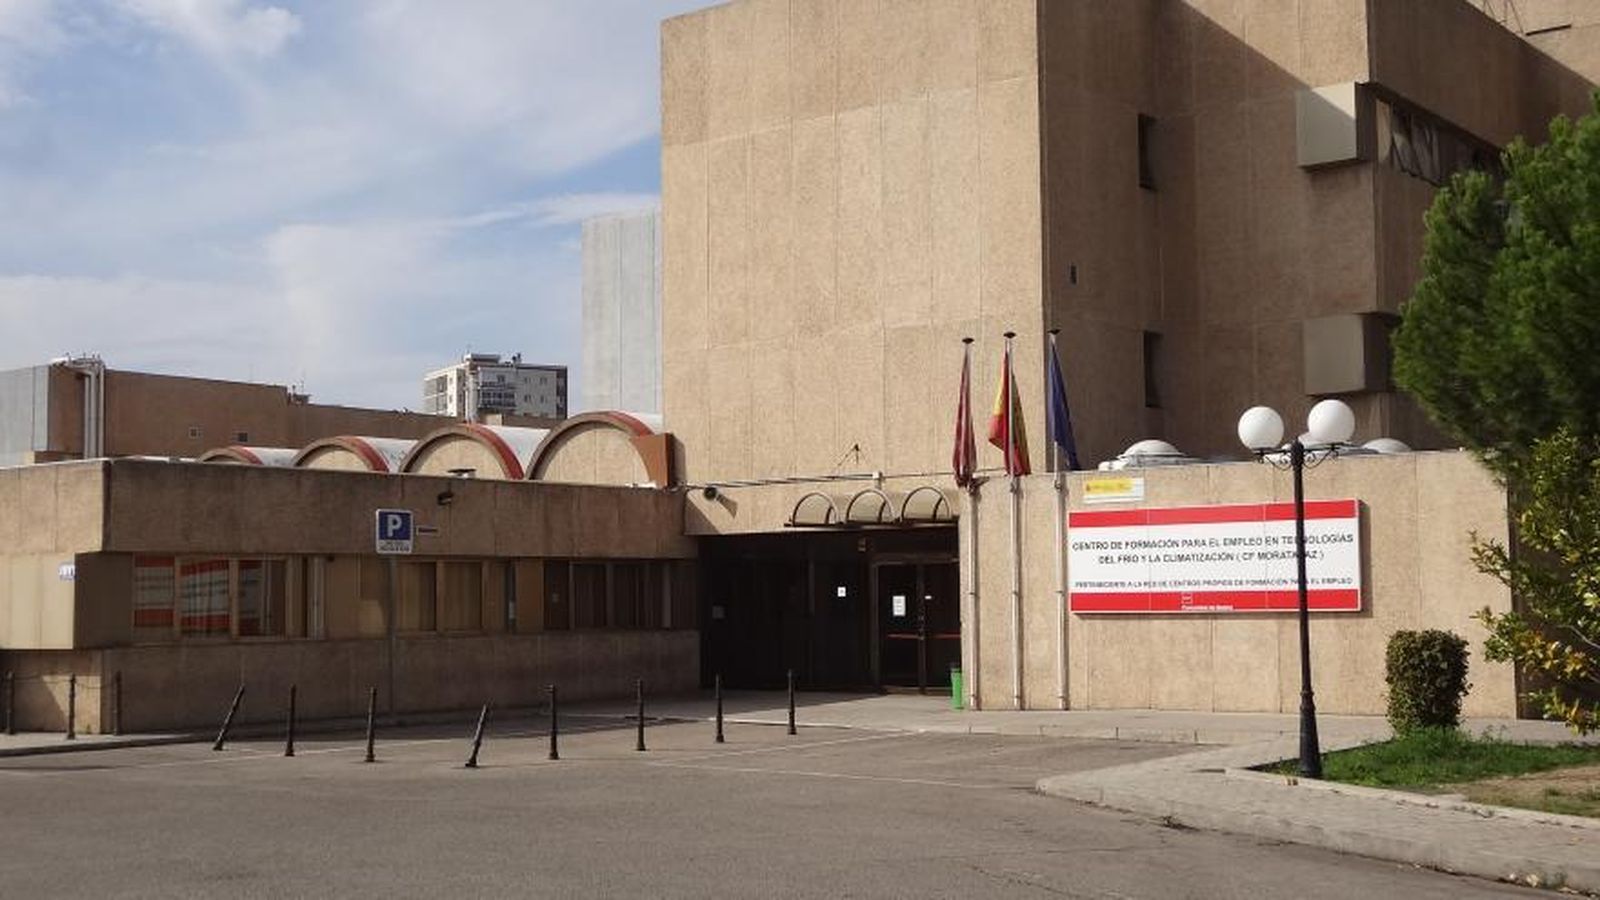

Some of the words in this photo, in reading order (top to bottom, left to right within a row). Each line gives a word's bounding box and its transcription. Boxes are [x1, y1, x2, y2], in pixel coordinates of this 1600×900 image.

[387, 514, 402, 538] P
[1071, 541, 1109, 551] CENTRO
[1110, 540, 1123, 550] DE
[1124, 538, 1180, 549] FORMACIÓN
[1181, 538, 1207, 548] PARA
[1208, 537, 1219, 548] EL
[1222, 536, 1263, 546] EMPLEO
[1264, 535, 1279, 546] EN
[1281, 533, 1354, 545] TEOLOGÍAS
[1098, 555, 1115, 564] DEL
[1140, 553, 1147, 563] Y
[1148, 552, 1161, 562] LA
[1257, 549, 1317, 561] MORATAAZ
